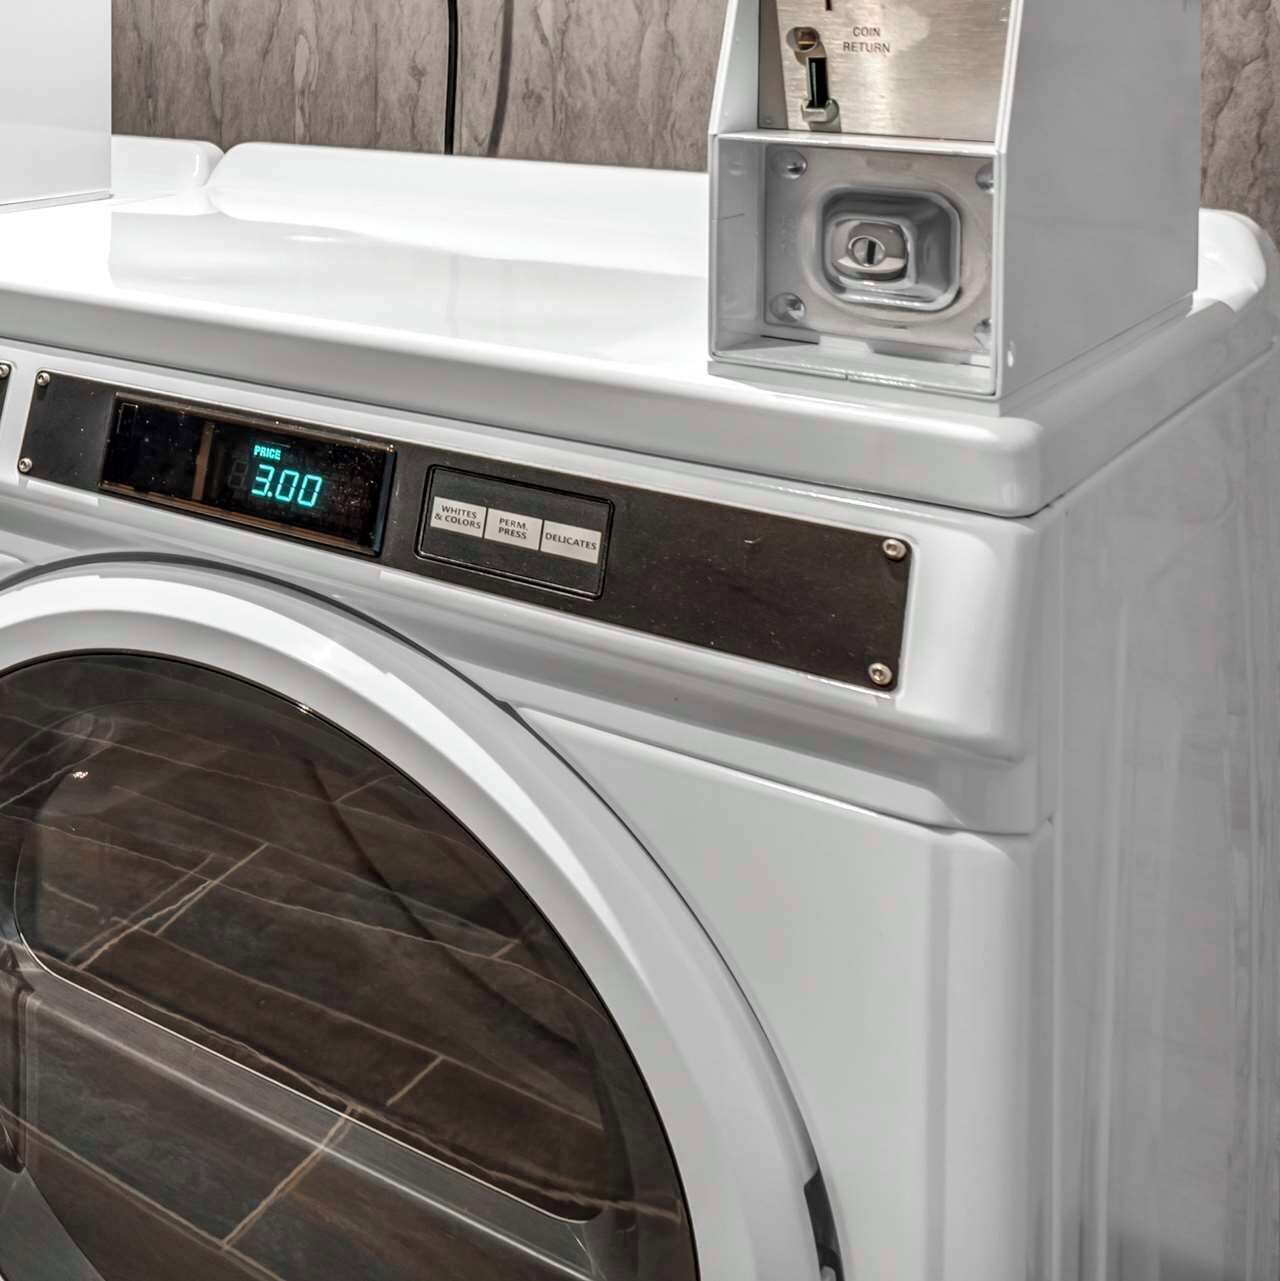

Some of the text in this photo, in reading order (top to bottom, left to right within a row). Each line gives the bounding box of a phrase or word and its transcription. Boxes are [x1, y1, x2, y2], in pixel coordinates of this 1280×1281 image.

[852, 26, 881, 37] COIN
[843, 41, 891, 53] RETURN
[253, 444, 282, 462] PRICE
[250, 463, 323, 508] 3.00
[441, 505, 477, 519] WHITES
[434, 513, 481, 529] & COLORS
[499, 518, 528, 531] PERM.
[498, 527, 527, 540] PRESS
[545, 532, 597, 550] DELICATES
